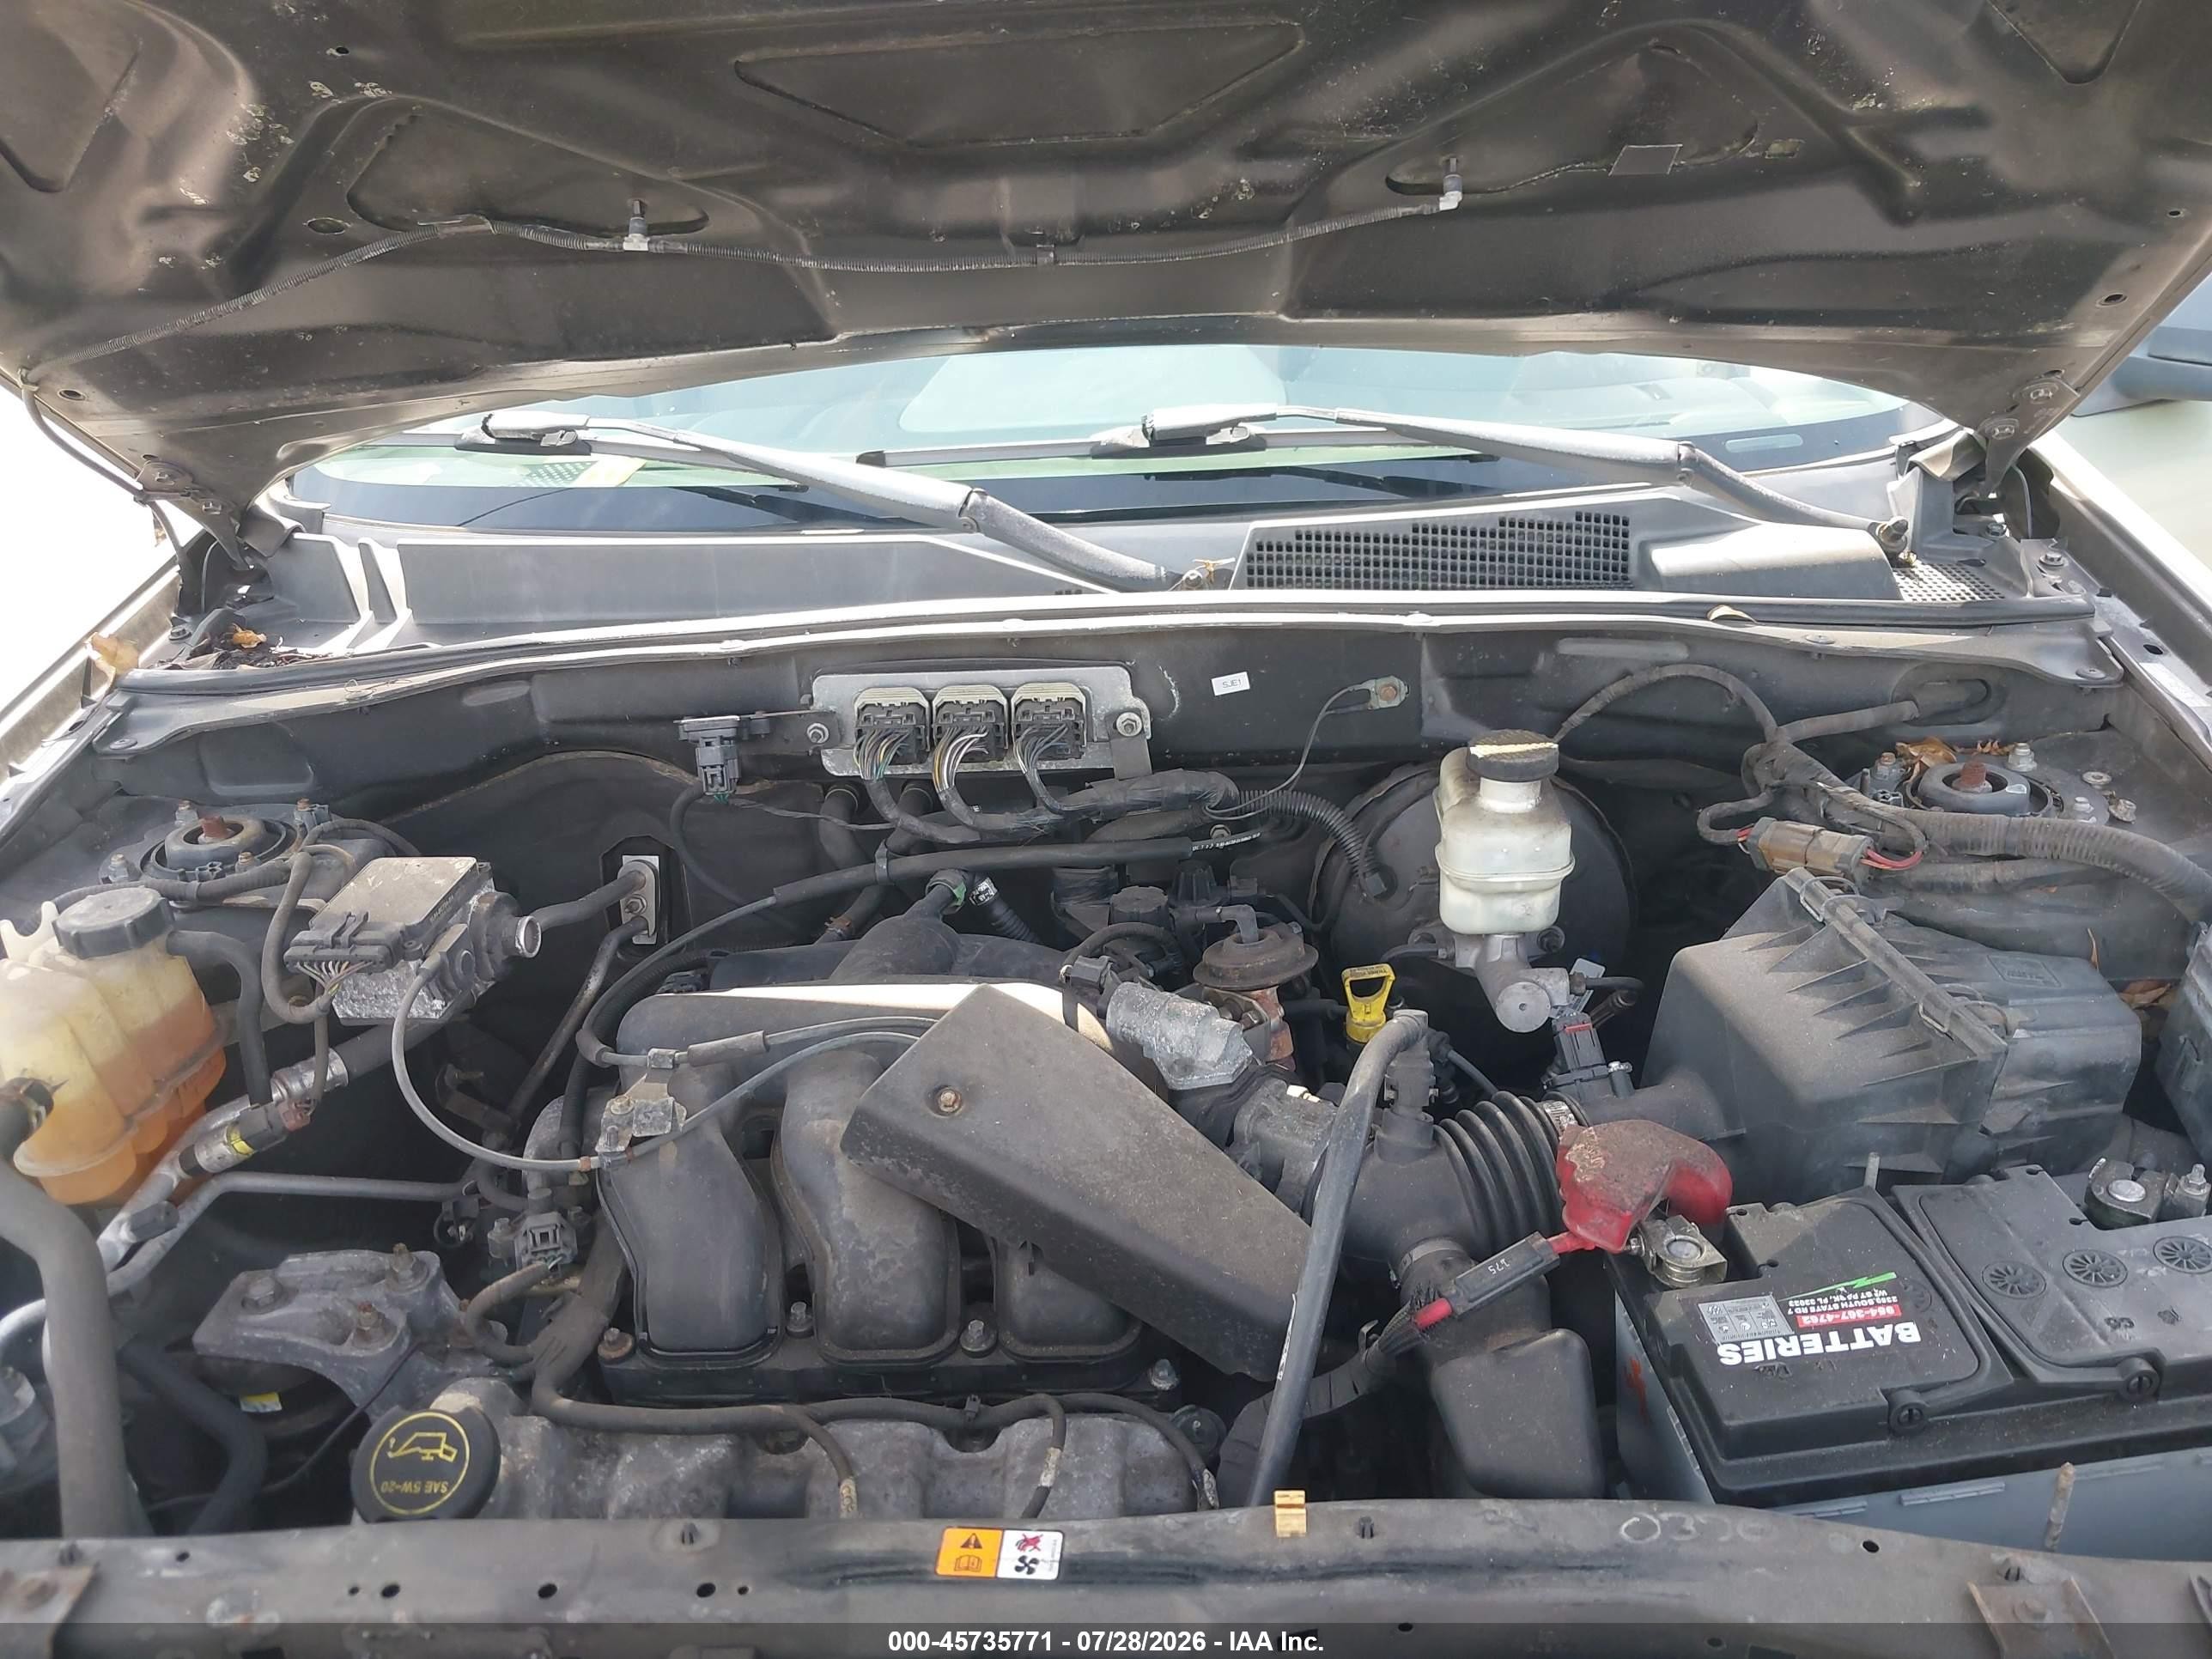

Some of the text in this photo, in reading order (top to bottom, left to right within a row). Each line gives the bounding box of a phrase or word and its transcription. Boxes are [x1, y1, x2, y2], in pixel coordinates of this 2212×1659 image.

[1717, 1321, 1922, 1365] BATTERIES
[380, 1480, 447, 1494] SAE 5W-20
